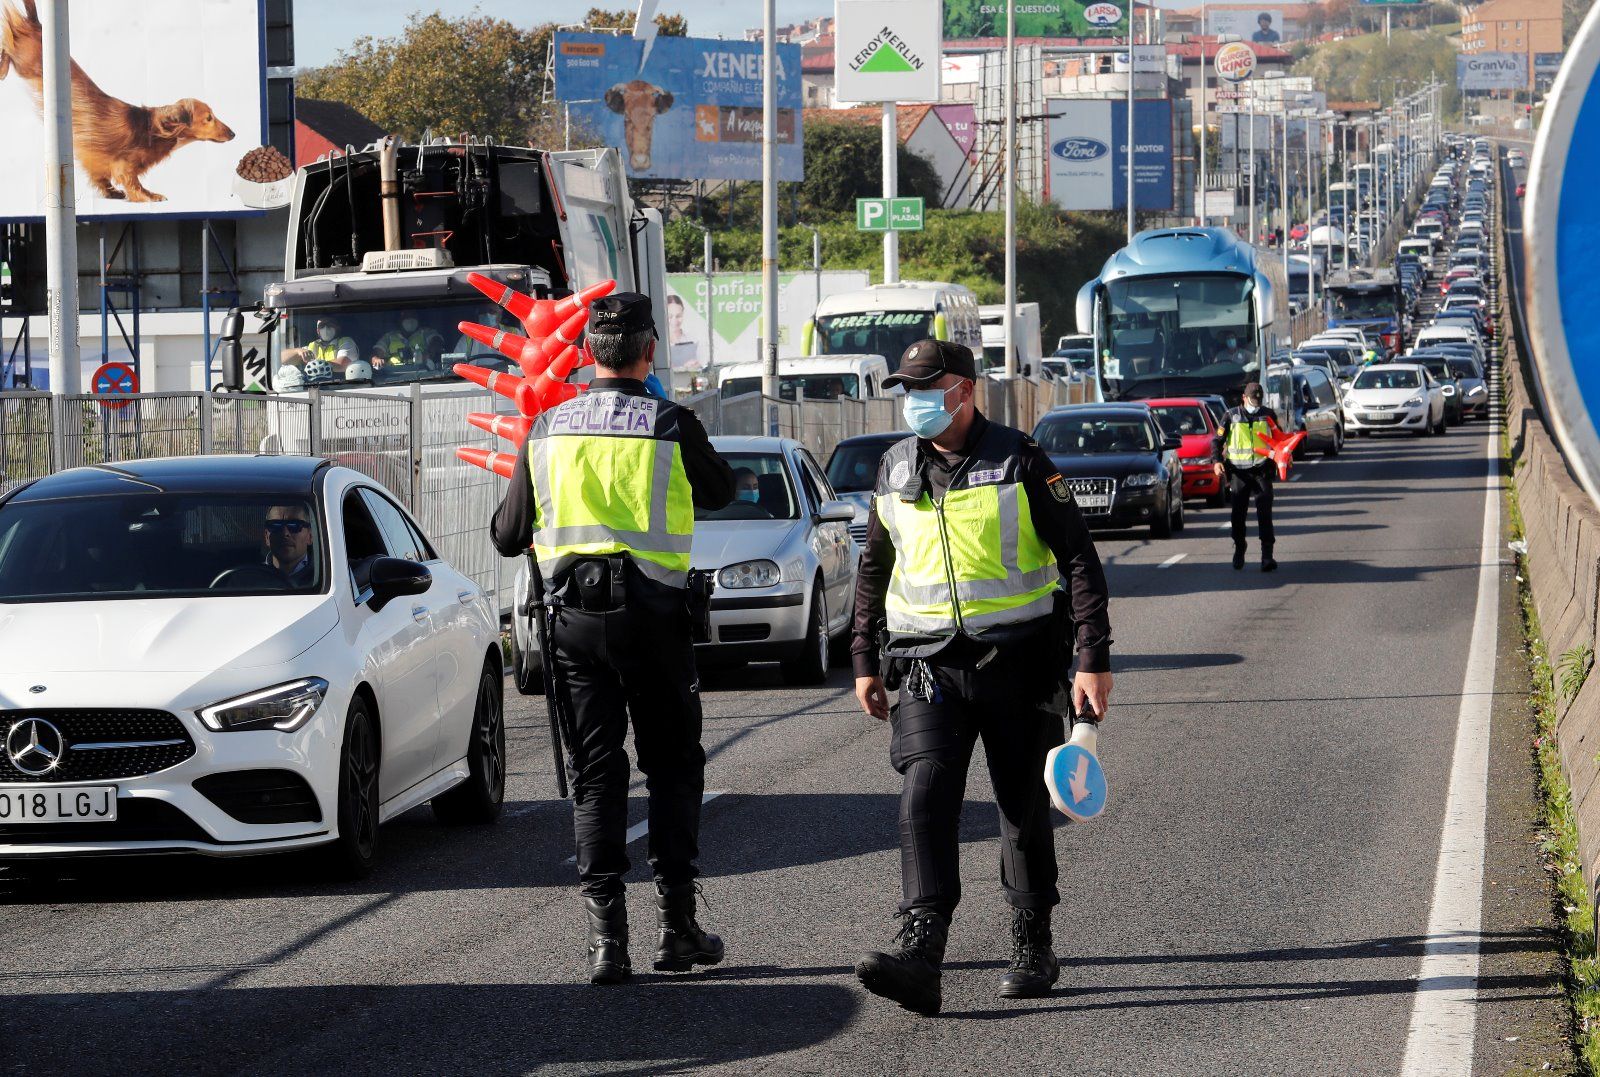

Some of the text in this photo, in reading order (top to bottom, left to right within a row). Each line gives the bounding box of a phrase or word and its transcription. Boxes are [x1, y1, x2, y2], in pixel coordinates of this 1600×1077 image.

[1088, 6, 1118, 17] LARSA
[848, 34, 883, 71] LEROY
[880, 26, 924, 70] MERLIN
[1222, 57, 1252, 72] KING
[955, 122, 968, 130] tu
[1062, 140, 1098, 158] Ford
[1120, 144, 1165, 153] GAMOTOR
[864, 202, 884, 227] P
[718, 298, 787, 313] refora
[597, 311, 618, 319] CNP
[830, 313, 925, 329] PEREZ LAMAS
[560, 396, 653, 411] CUERPO NACIONAL DE
[335, 411, 400, 430] Concello
[552, 410, 650, 431] POLICIA
[57, 792, 109, 817] LGJ
